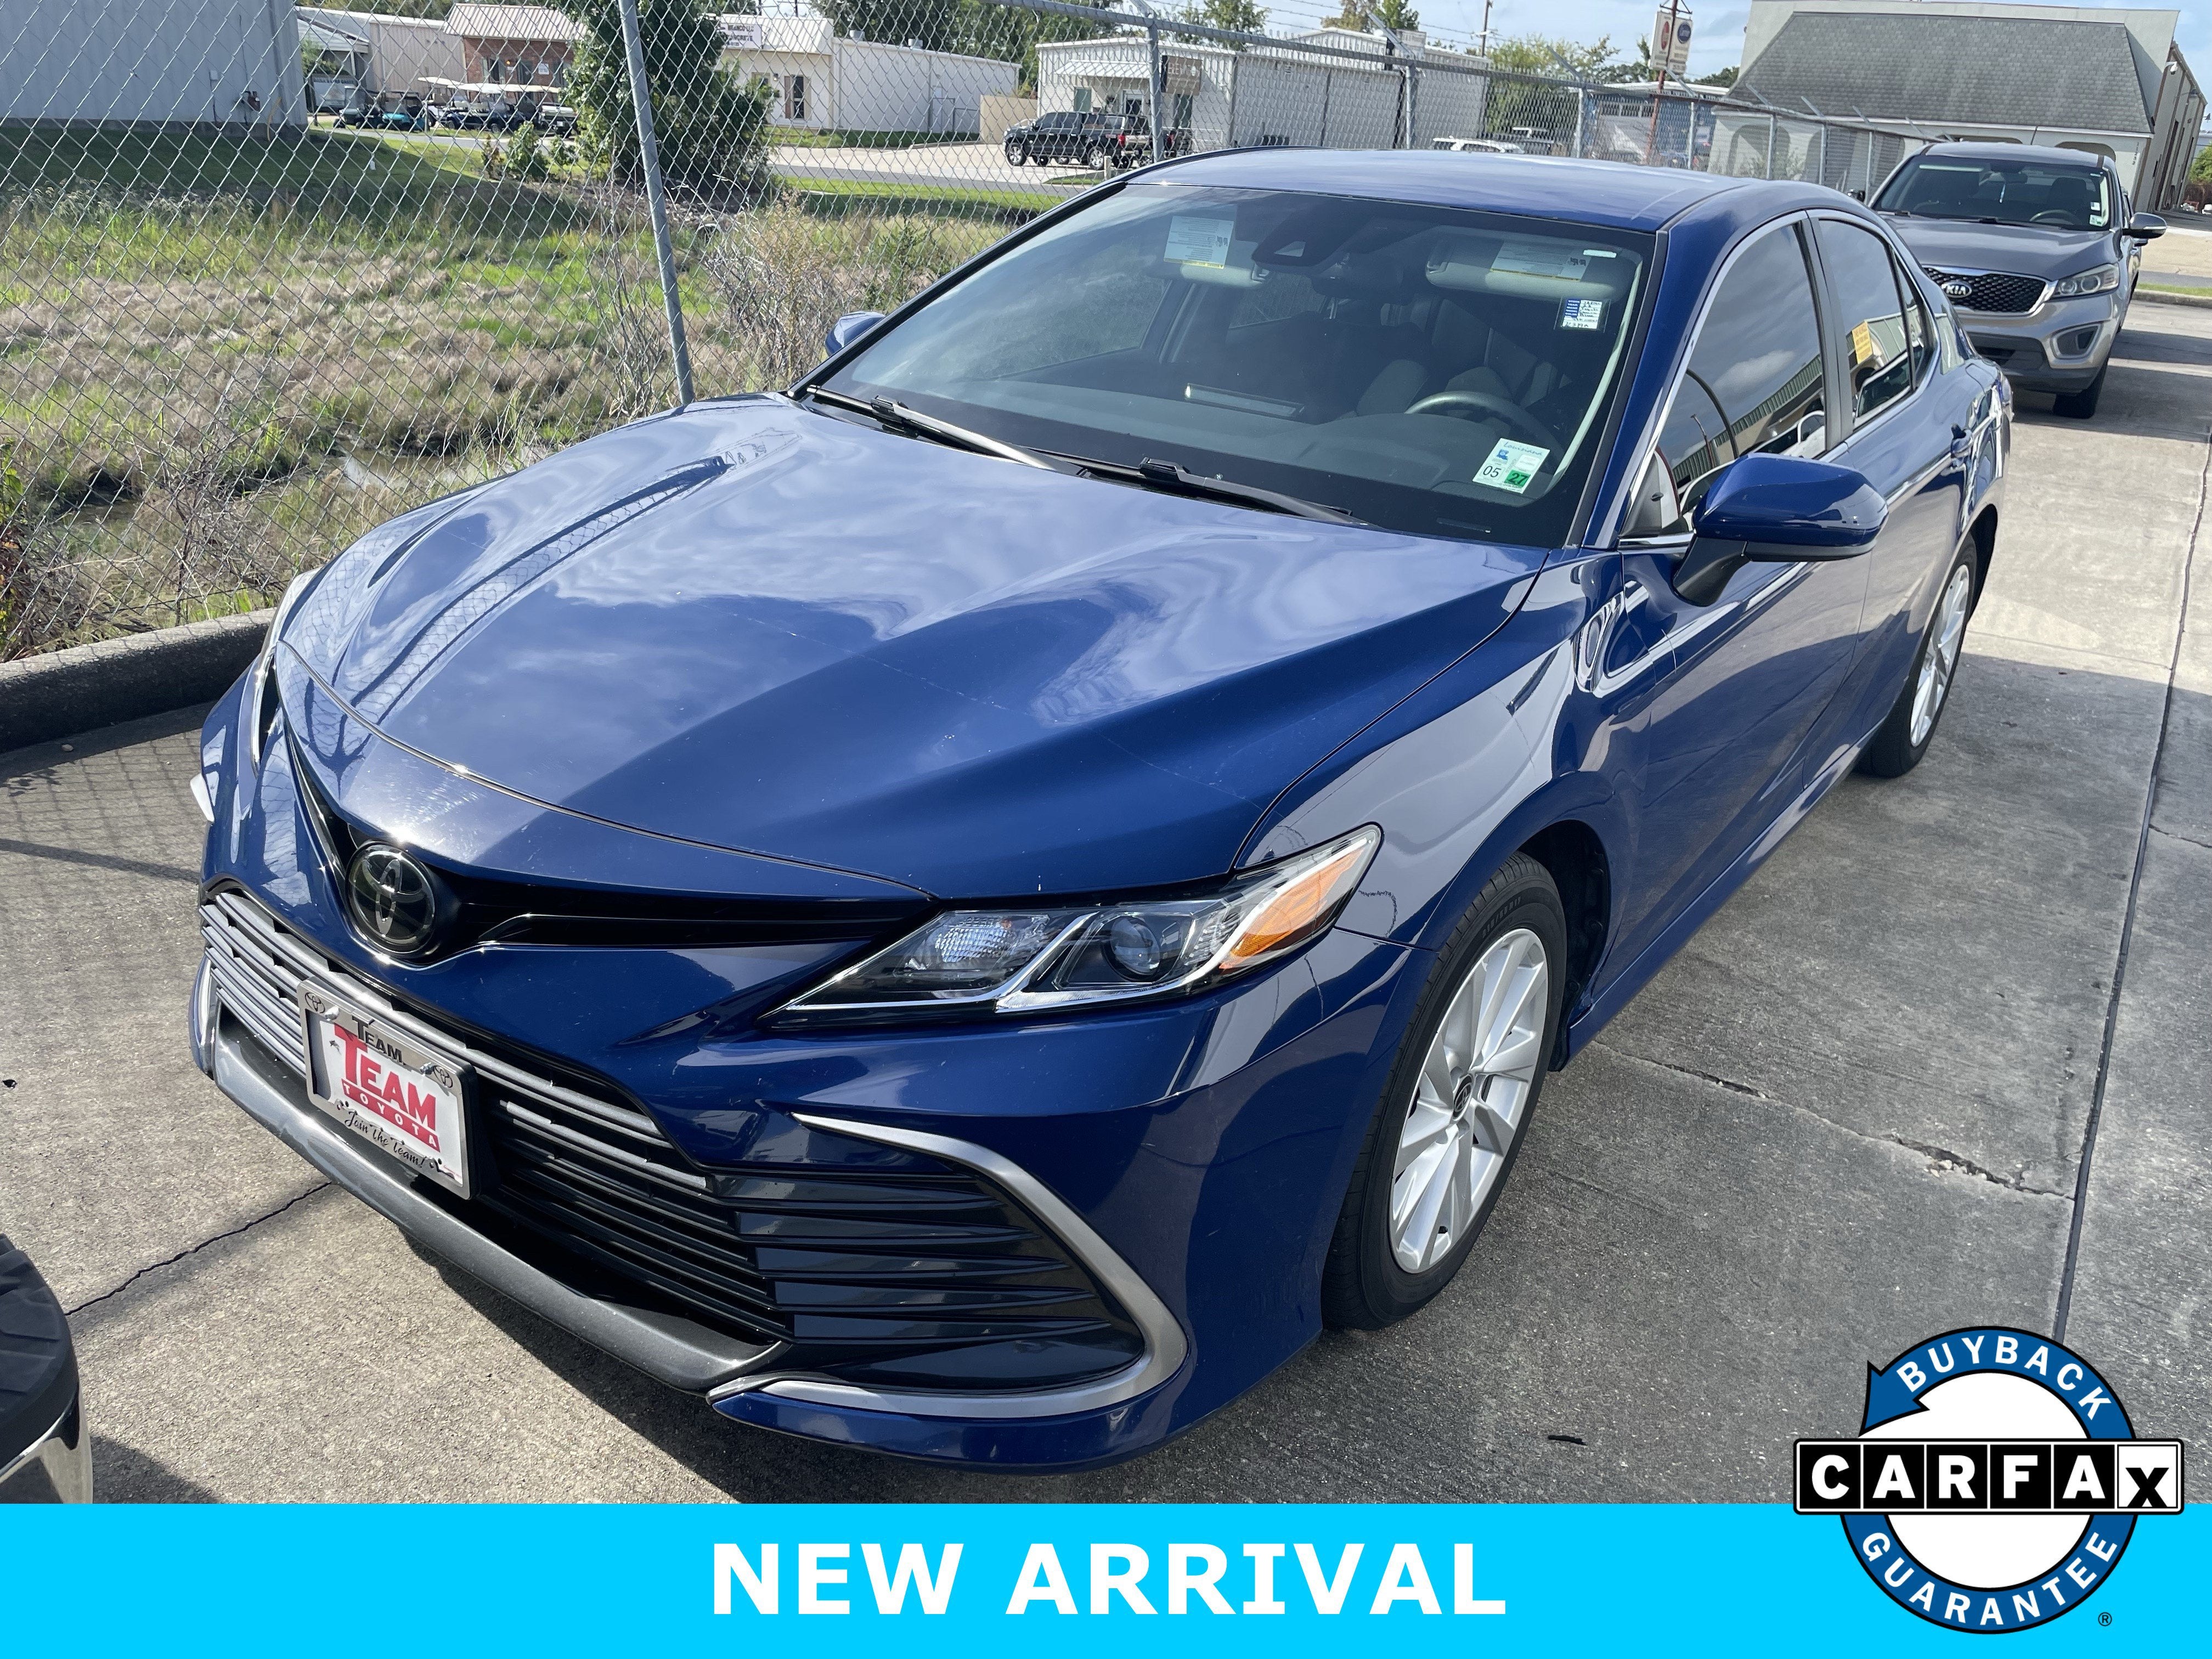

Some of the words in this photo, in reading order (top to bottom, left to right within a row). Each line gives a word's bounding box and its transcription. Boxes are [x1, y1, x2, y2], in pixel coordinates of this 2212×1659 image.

[1946, 285, 1966, 295] KIA
[1483, 465, 1502, 478] 05
[1509, 473, 1528, 485] 27
[334, 1023, 436, 1131] TEAM
[343, 1082, 437, 1148] TOYOTA
[345, 1110, 368, 1133] Join
[370, 1124, 389, 1146] the
